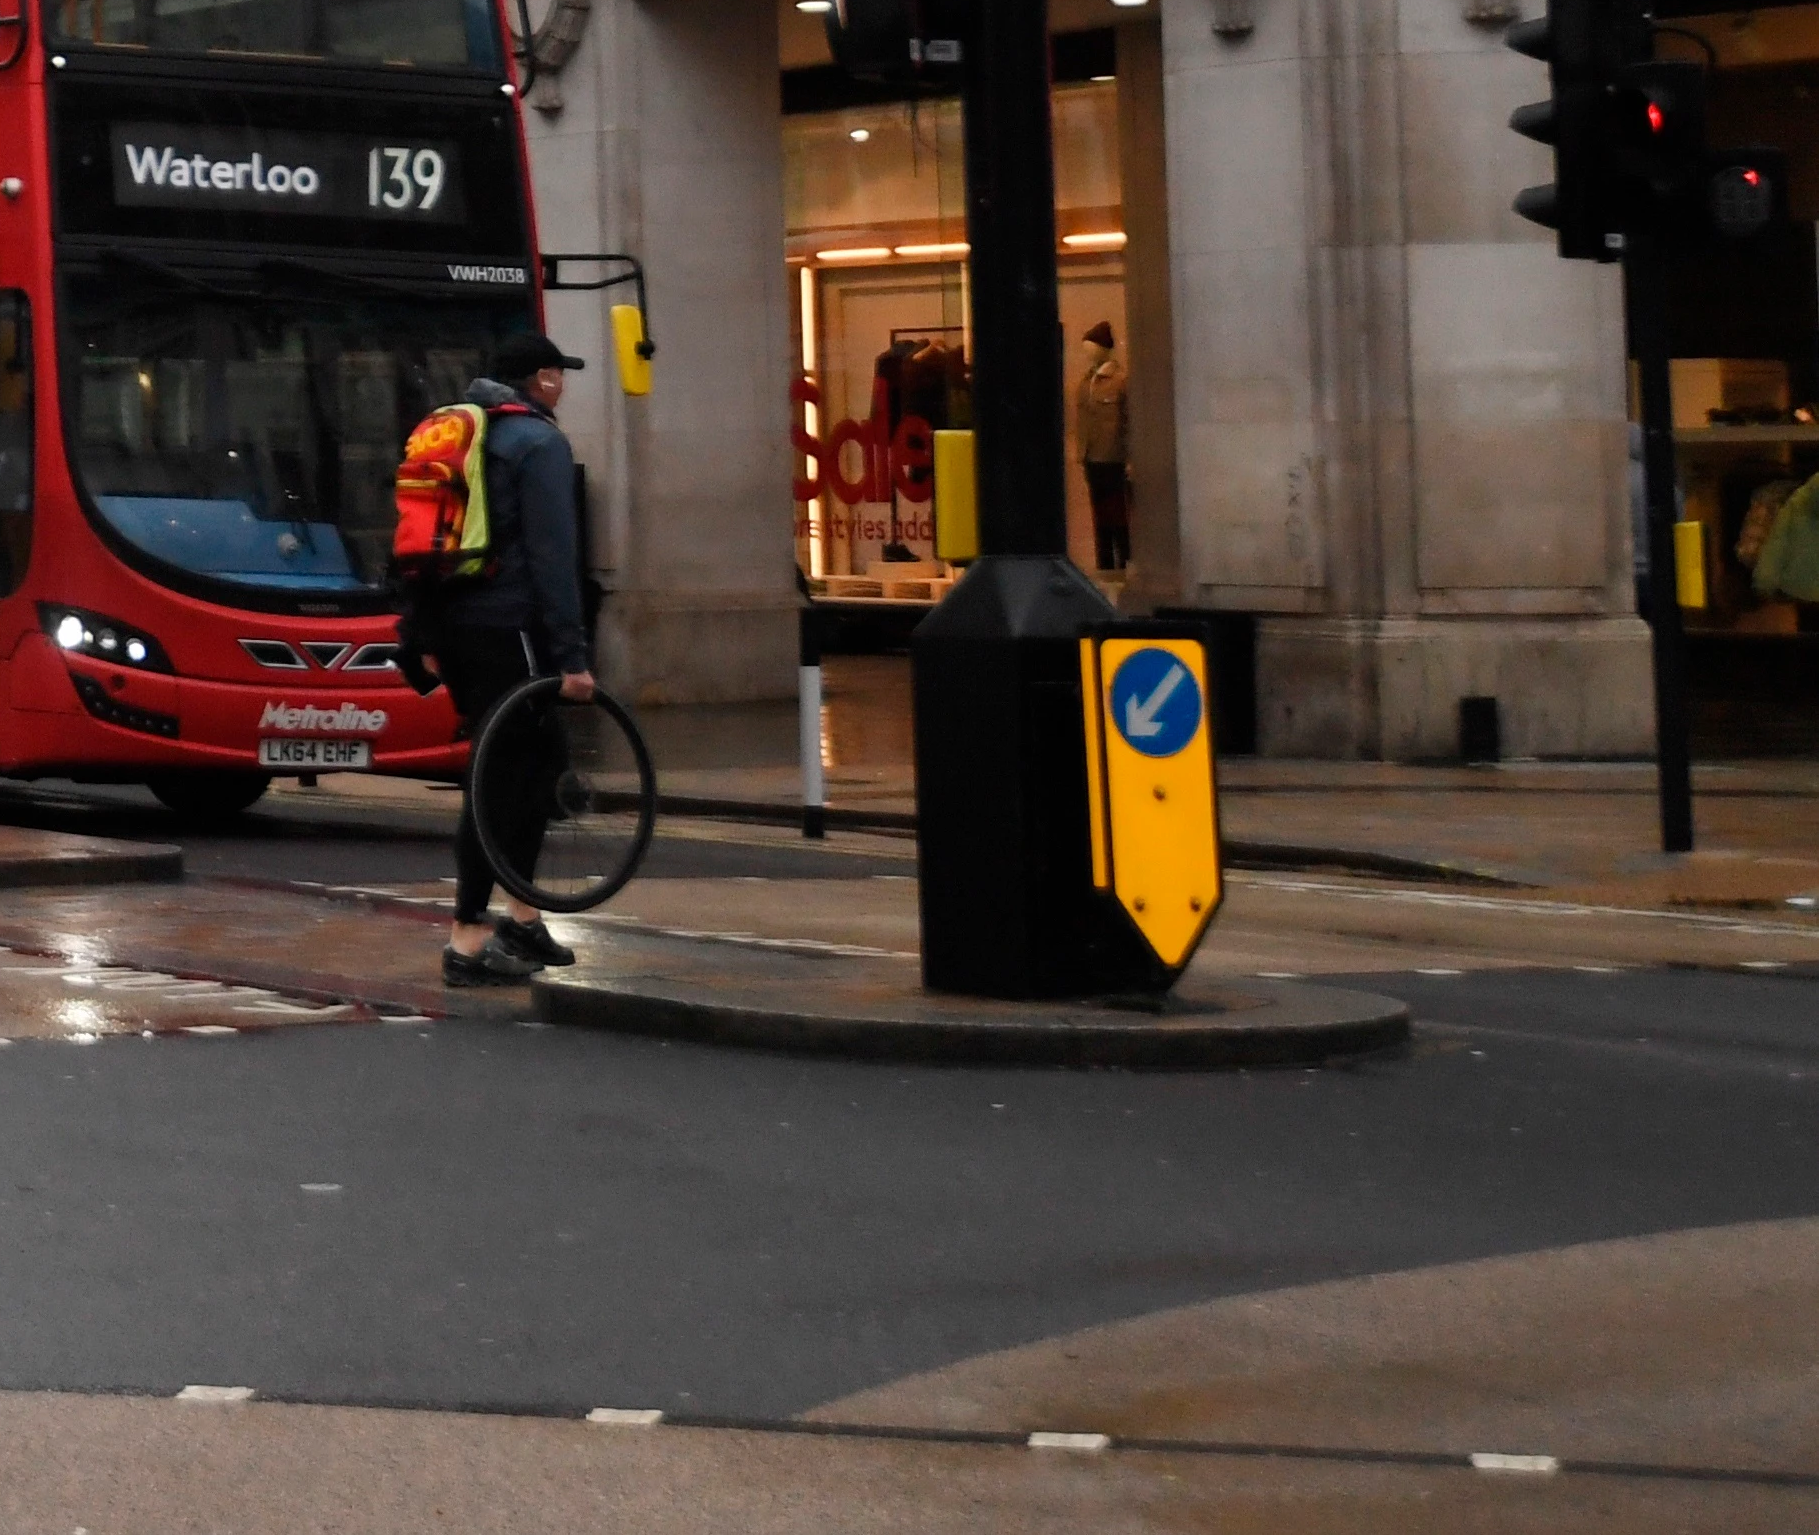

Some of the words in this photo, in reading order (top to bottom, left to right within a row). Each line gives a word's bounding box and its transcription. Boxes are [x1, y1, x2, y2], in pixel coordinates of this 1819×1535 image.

[125, 144, 320, 195] Waterloo
[368, 147, 443, 209] 139
[791, 377, 934, 506] Sale
[258, 701, 388, 732] Metroline
[267, 741, 317, 761] LK64
[323, 742, 360, 763] EHF
